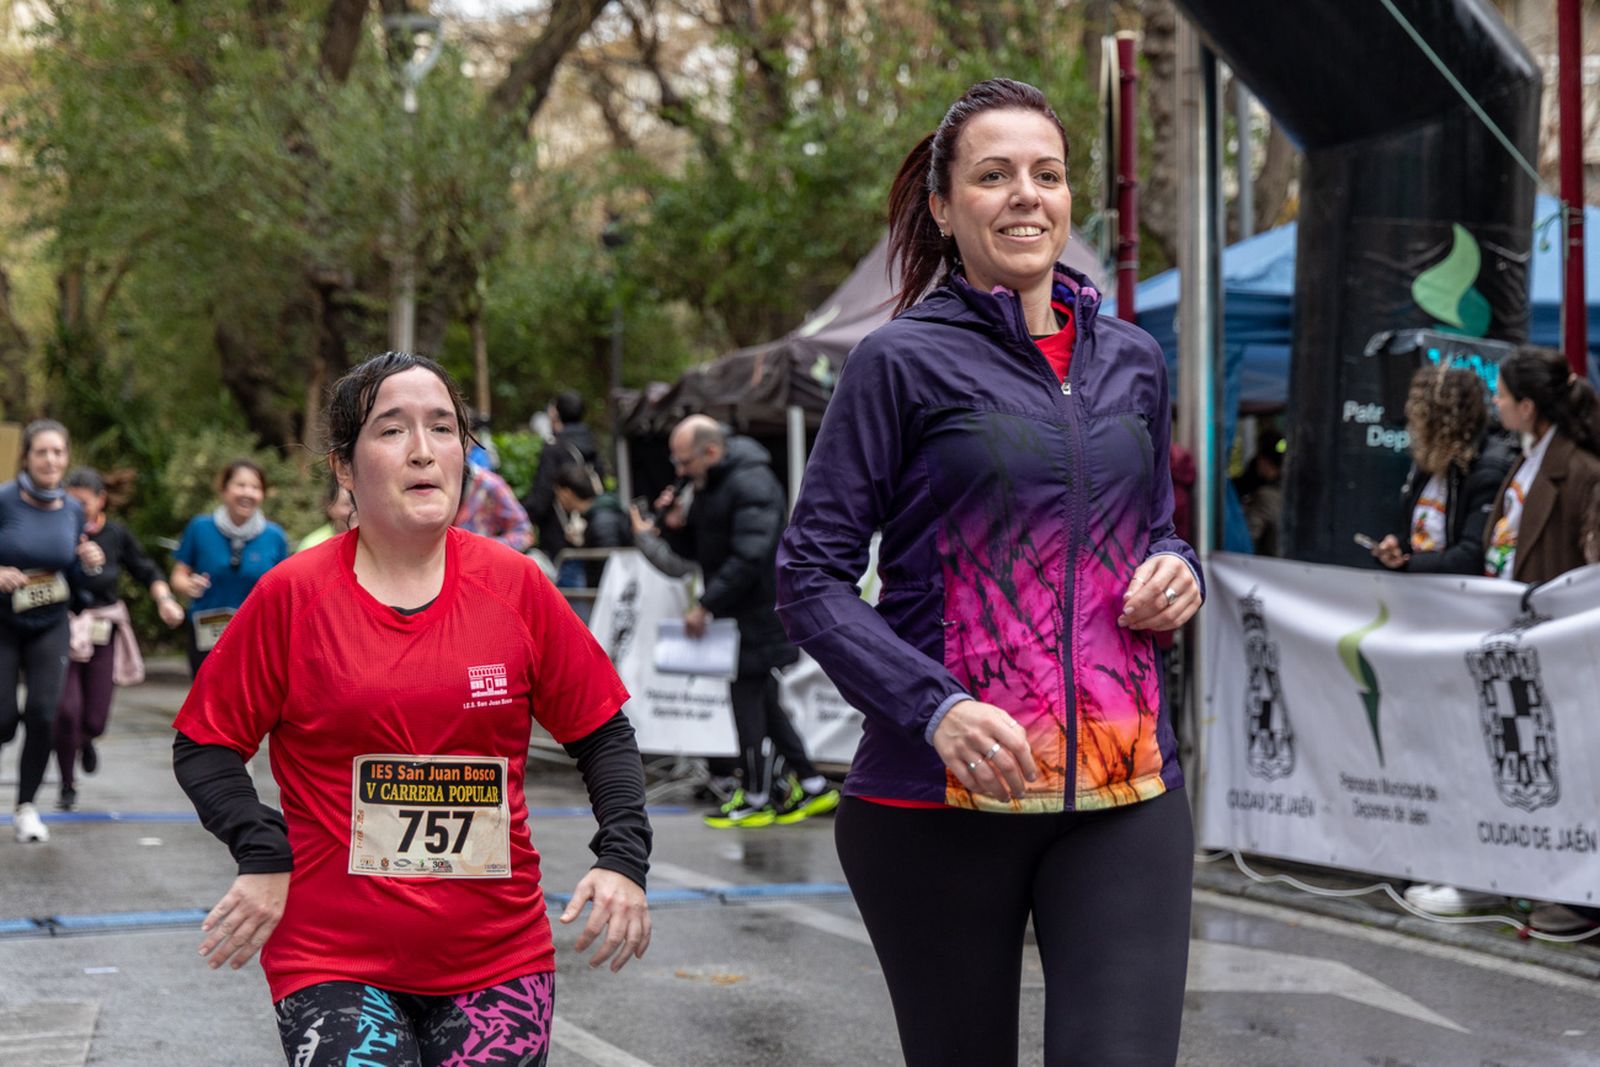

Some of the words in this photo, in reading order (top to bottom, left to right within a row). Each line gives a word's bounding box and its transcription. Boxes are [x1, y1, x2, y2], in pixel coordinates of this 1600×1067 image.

[1343, 400, 1385, 423] Patr
[1366, 425, 1411, 452] Dep
[371, 764, 393, 779] IES
[397, 765, 425, 781] San
[428, 766, 460, 781] Juan
[464, 766, 496, 781] Bosco
[366, 782, 377, 799] V
[380, 783, 445, 802] CARRERA
[449, 785, 499, 803] POPULAR
[397, 809, 475, 854] 757
[1478, 820, 1531, 848] CIUDAD
[1532, 825, 1552, 851] DE
[1554, 823, 1598, 853] JAÉN
